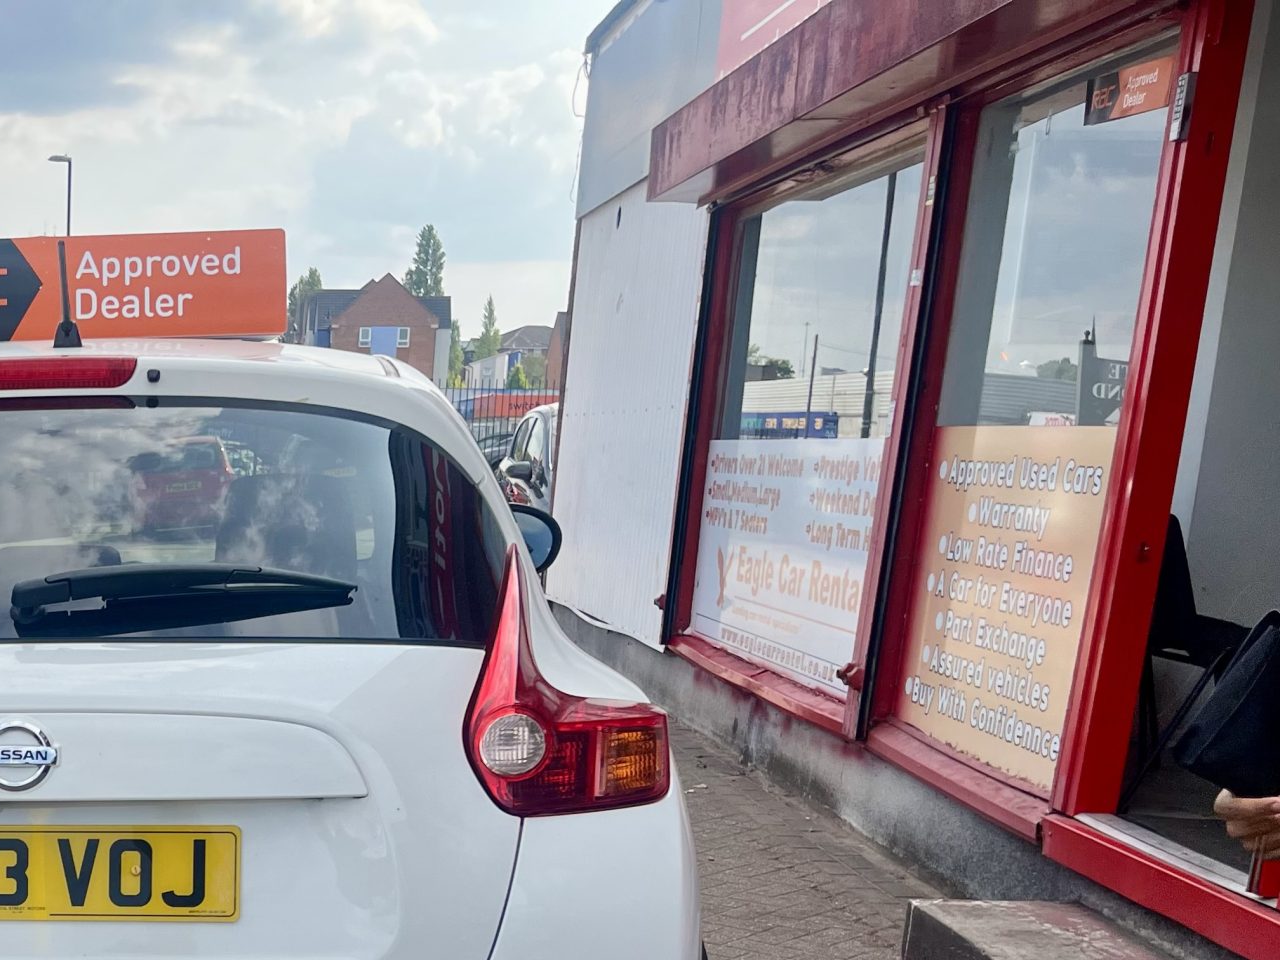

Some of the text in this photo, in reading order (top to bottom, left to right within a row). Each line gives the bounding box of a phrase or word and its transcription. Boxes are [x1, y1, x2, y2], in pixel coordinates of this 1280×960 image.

[1122, 92, 1146, 108] Dealer
[1126, 68, 1159, 90] Approved
[75, 245, 241, 287] Approved
[75, 286, 193, 320] Dealer
[714, 453, 738, 475] Drivers
[767, 453, 804, 478] Welcome
[818, 455, 859, 486] Prestige
[948, 454, 1104, 496] Approved Used Cars
[740, 510, 768, 534] Seaters
[815, 487, 862, 516] Weekend
[978, 495, 1051, 541] Warranty
[810, 519, 834, 551] Long
[835, 522, 861, 551] Term
[736, 545, 774, 597] Eagle
[779, 553, 806, 598] Car
[946, 531, 1073, 582] Low Rate Finance
[935, 569, 1073, 628] A Car for Everyone
[943, 609, 1047, 669] Part Exchange
[929, 643, 1051, 712] Assured vehicles
[911, 675, 935, 716] Buy
[937, 684, 968, 723] With
[57, 838, 207, 908] VOJ
